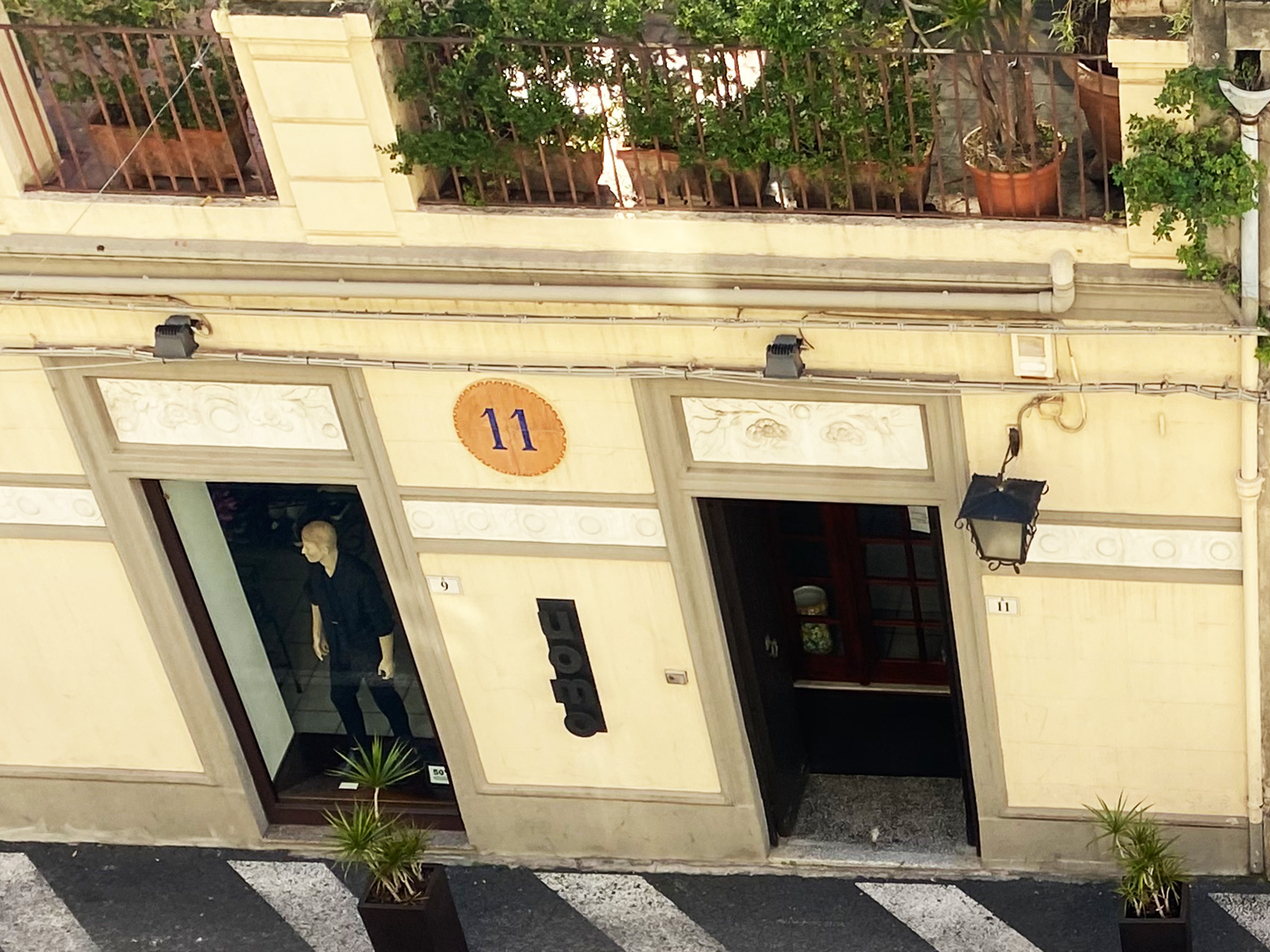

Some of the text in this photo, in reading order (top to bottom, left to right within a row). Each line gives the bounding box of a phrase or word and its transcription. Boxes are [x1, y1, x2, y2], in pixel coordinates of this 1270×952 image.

[480, 407, 538, 452] 11
[441, 581, 449, 591] 9
[998, 602, 1009, 612] 11
